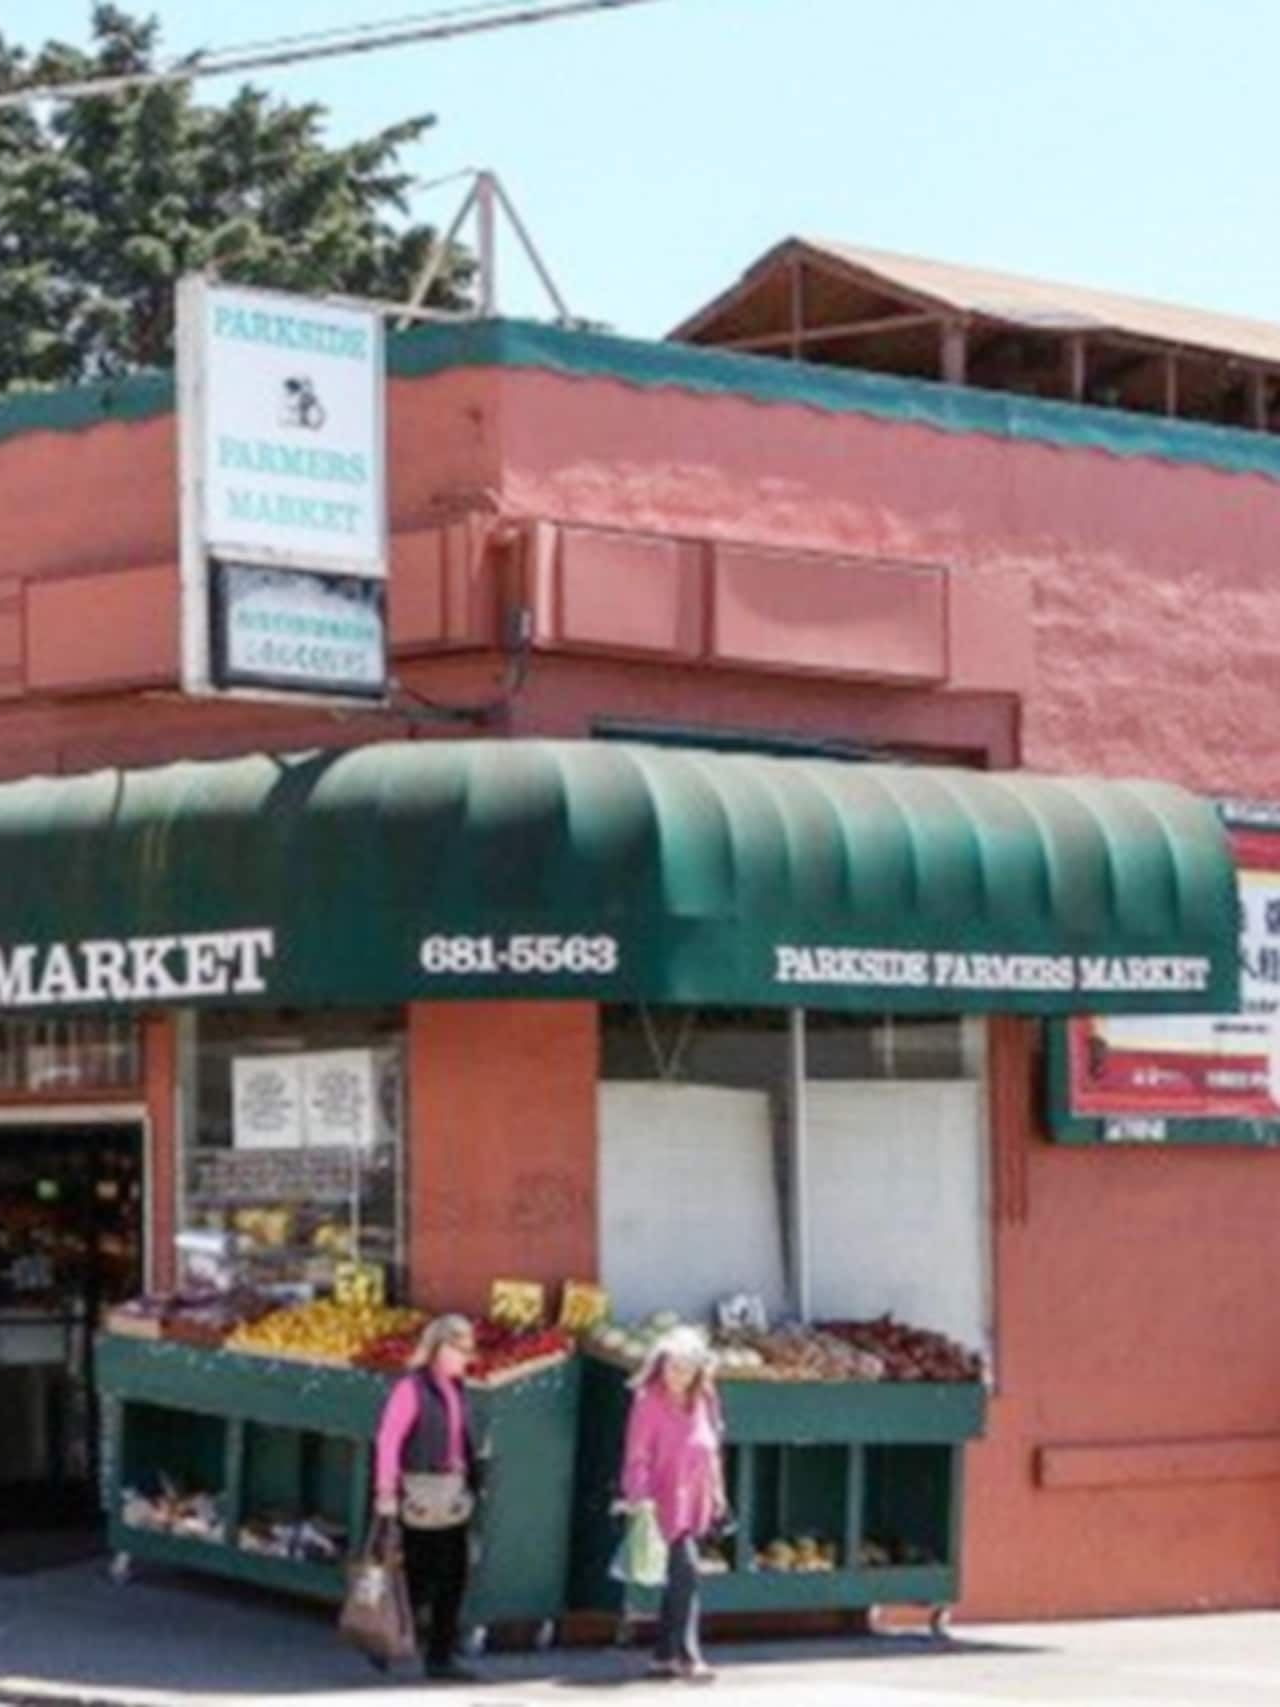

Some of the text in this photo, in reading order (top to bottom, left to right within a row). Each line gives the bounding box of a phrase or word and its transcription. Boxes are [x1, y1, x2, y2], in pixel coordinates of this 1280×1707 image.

[213, 306, 368, 361] PARKSIDE
[419, 934, 619, 975] 681-5563
[775, 945, 929, 985] PARKSIDE
[933, 950, 1075, 991] FARMERS
[1079, 956, 1210, 992] MARKET
